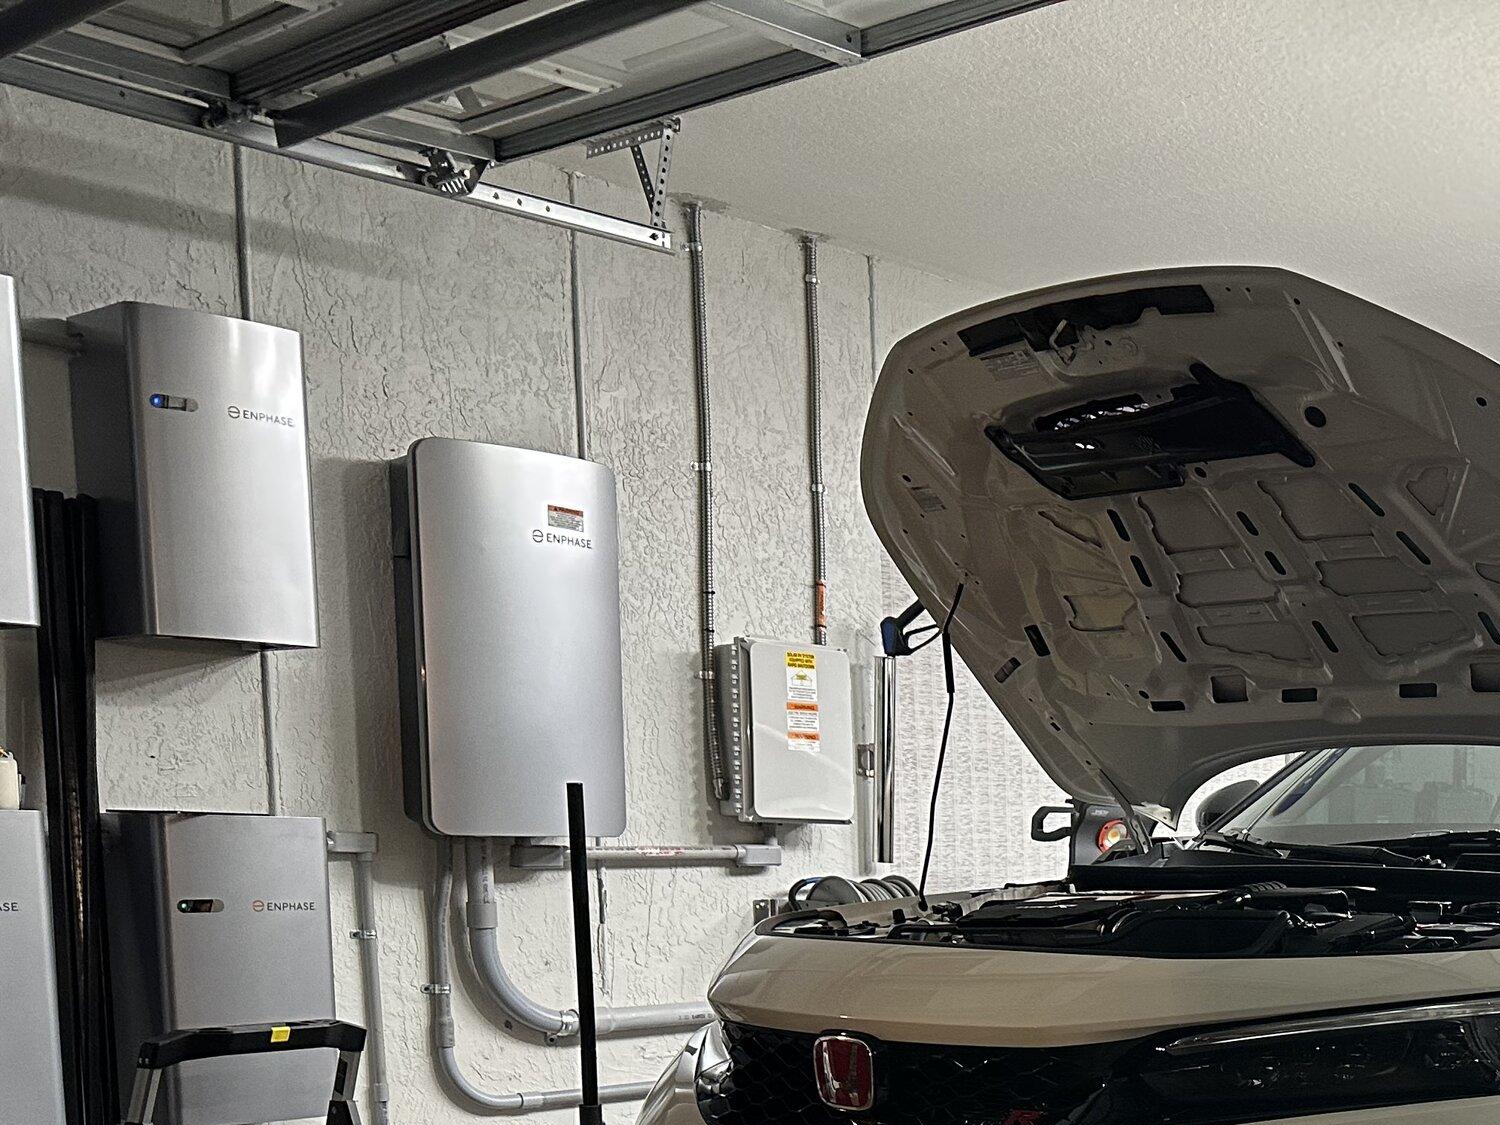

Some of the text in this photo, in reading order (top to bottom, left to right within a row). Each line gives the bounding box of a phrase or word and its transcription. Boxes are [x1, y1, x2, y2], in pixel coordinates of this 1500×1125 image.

[243, 409, 295, 428] ENPHASE
[546, 533, 593, 549] ENPHASE
[0, 902, 18, 911] SE
[267, 902, 315, 911] ENPHASE
